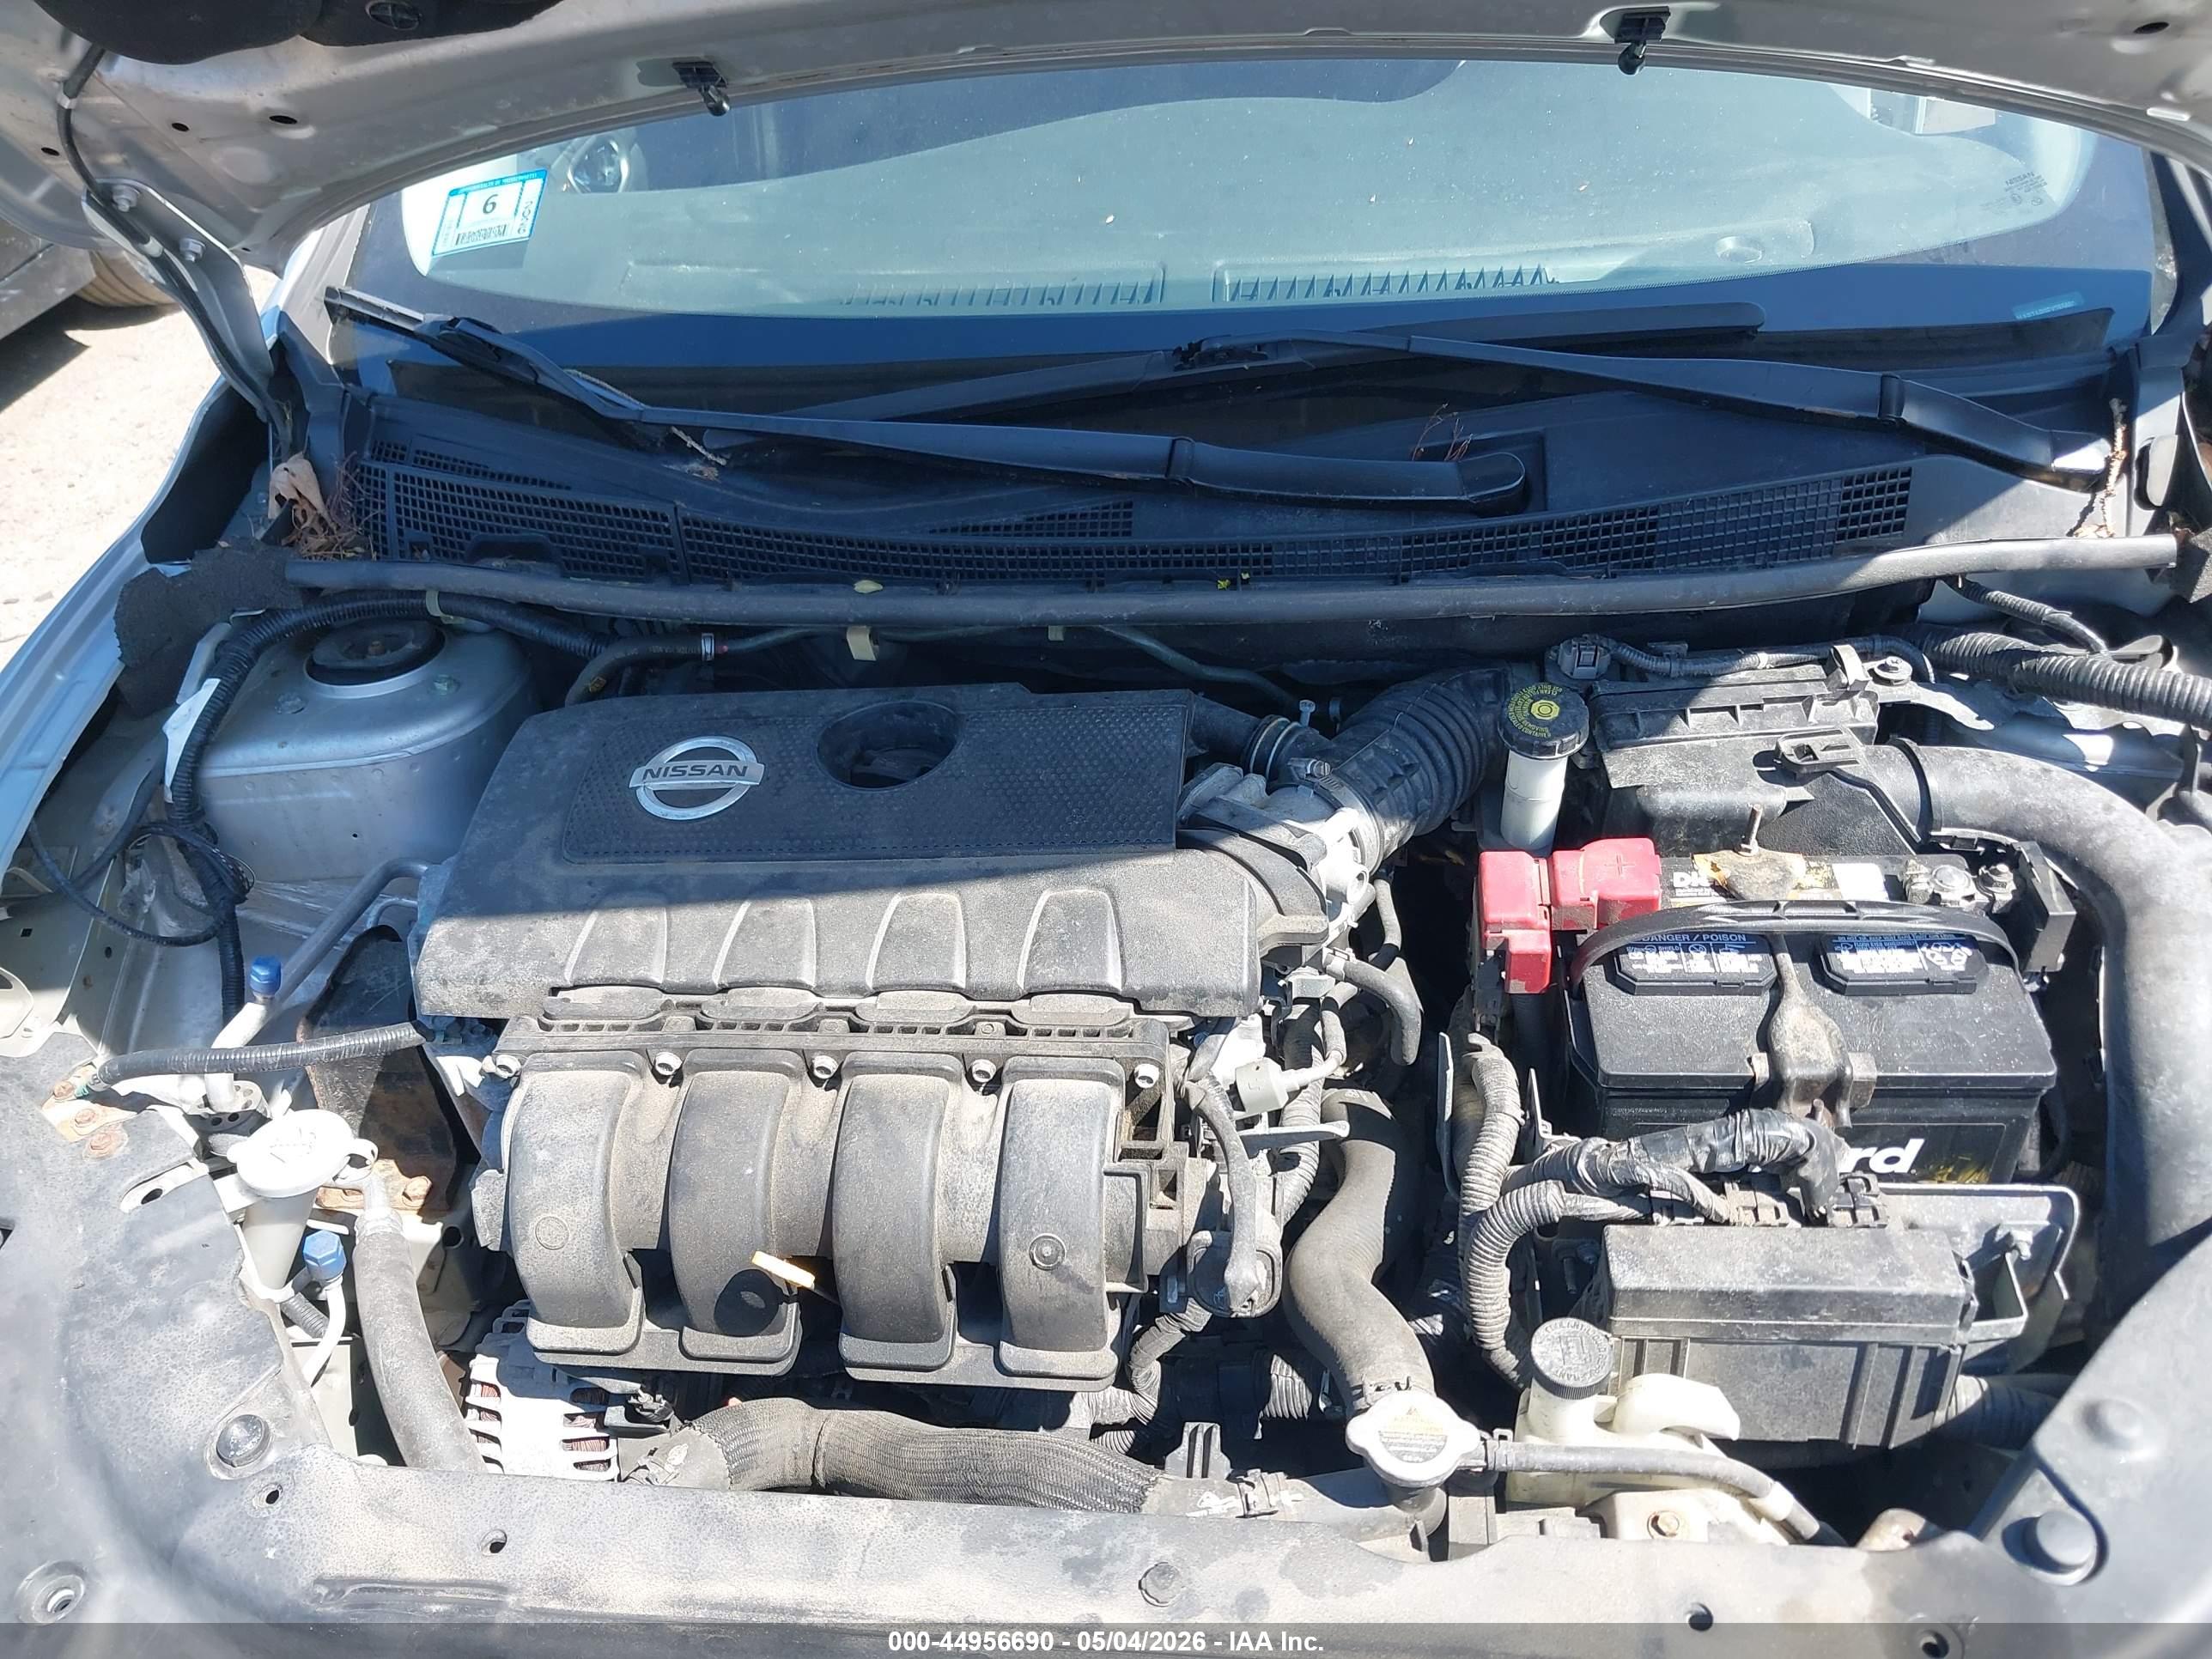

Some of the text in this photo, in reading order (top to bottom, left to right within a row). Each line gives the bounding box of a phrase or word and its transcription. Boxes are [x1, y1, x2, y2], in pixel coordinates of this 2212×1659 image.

[482, 193, 499, 215] 6
[642, 764, 748, 780] NISSAN
[1702, 933, 1747, 942] POISON
